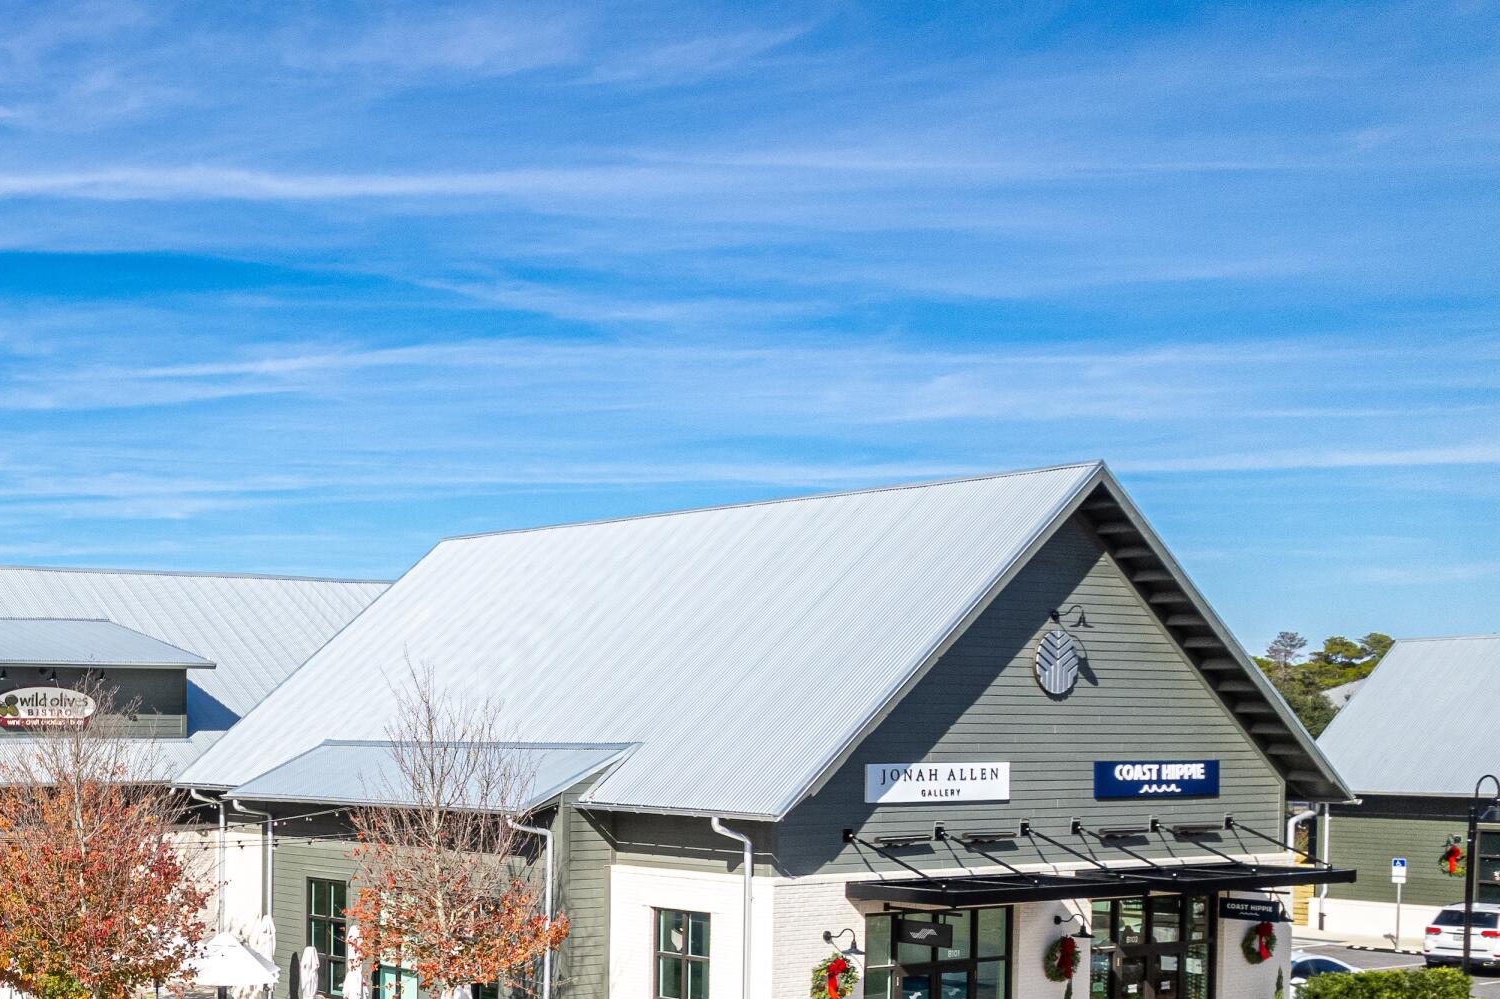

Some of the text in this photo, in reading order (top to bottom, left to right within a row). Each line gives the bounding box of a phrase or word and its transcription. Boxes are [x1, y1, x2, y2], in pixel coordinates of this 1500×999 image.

[20, 692, 47, 707] wild
[28, 708, 72, 717] BISTRO
[881, 768, 999, 785] JONAH ALLEN
[1114, 763, 1205, 781] COAST HIPPIE
[921, 788, 961, 797] GALLERY
[1226, 903, 1273, 913] COAST HIPPIE
